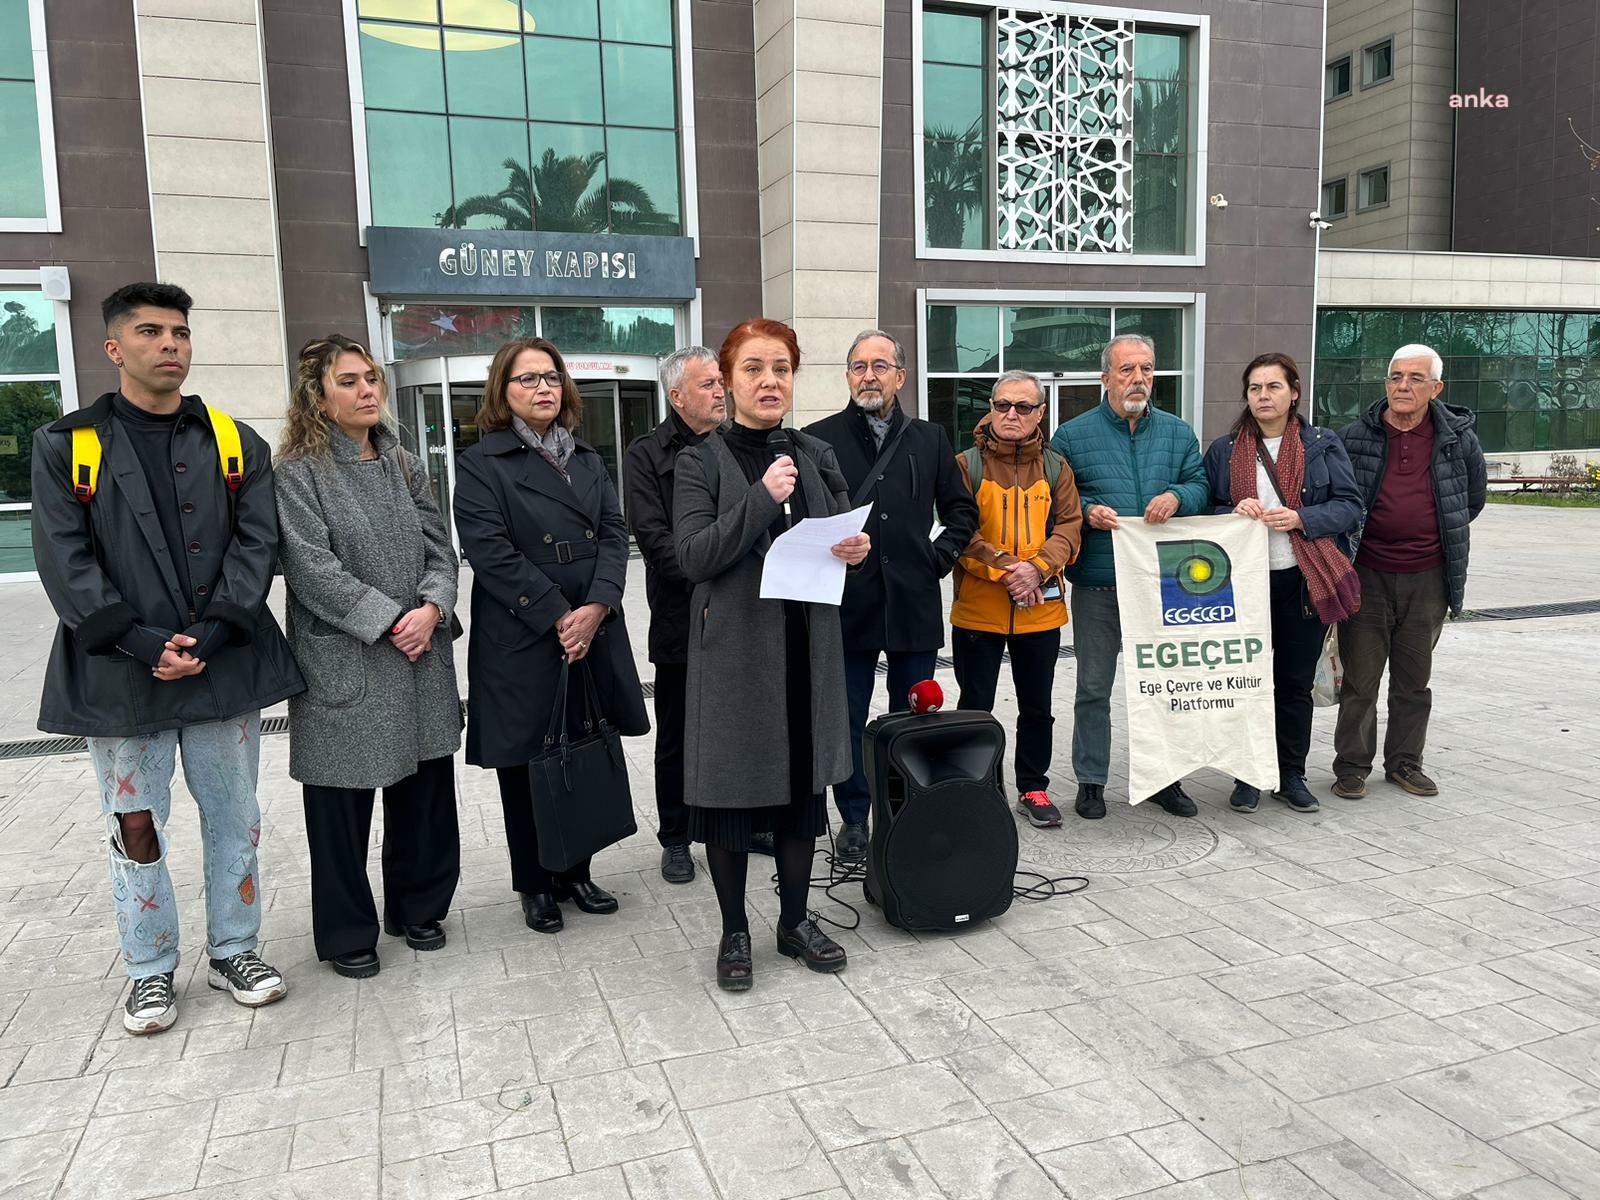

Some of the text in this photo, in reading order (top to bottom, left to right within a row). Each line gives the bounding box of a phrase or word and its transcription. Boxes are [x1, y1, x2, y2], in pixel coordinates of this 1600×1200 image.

[438, 242, 637, 279] GÜNEY KAPISI
[1135, 637, 1264, 671] EGEÇEP
[1139, 676, 1262, 696] Ege Çevre ve Kültür
[1170, 697, 1235, 712] Platformu
